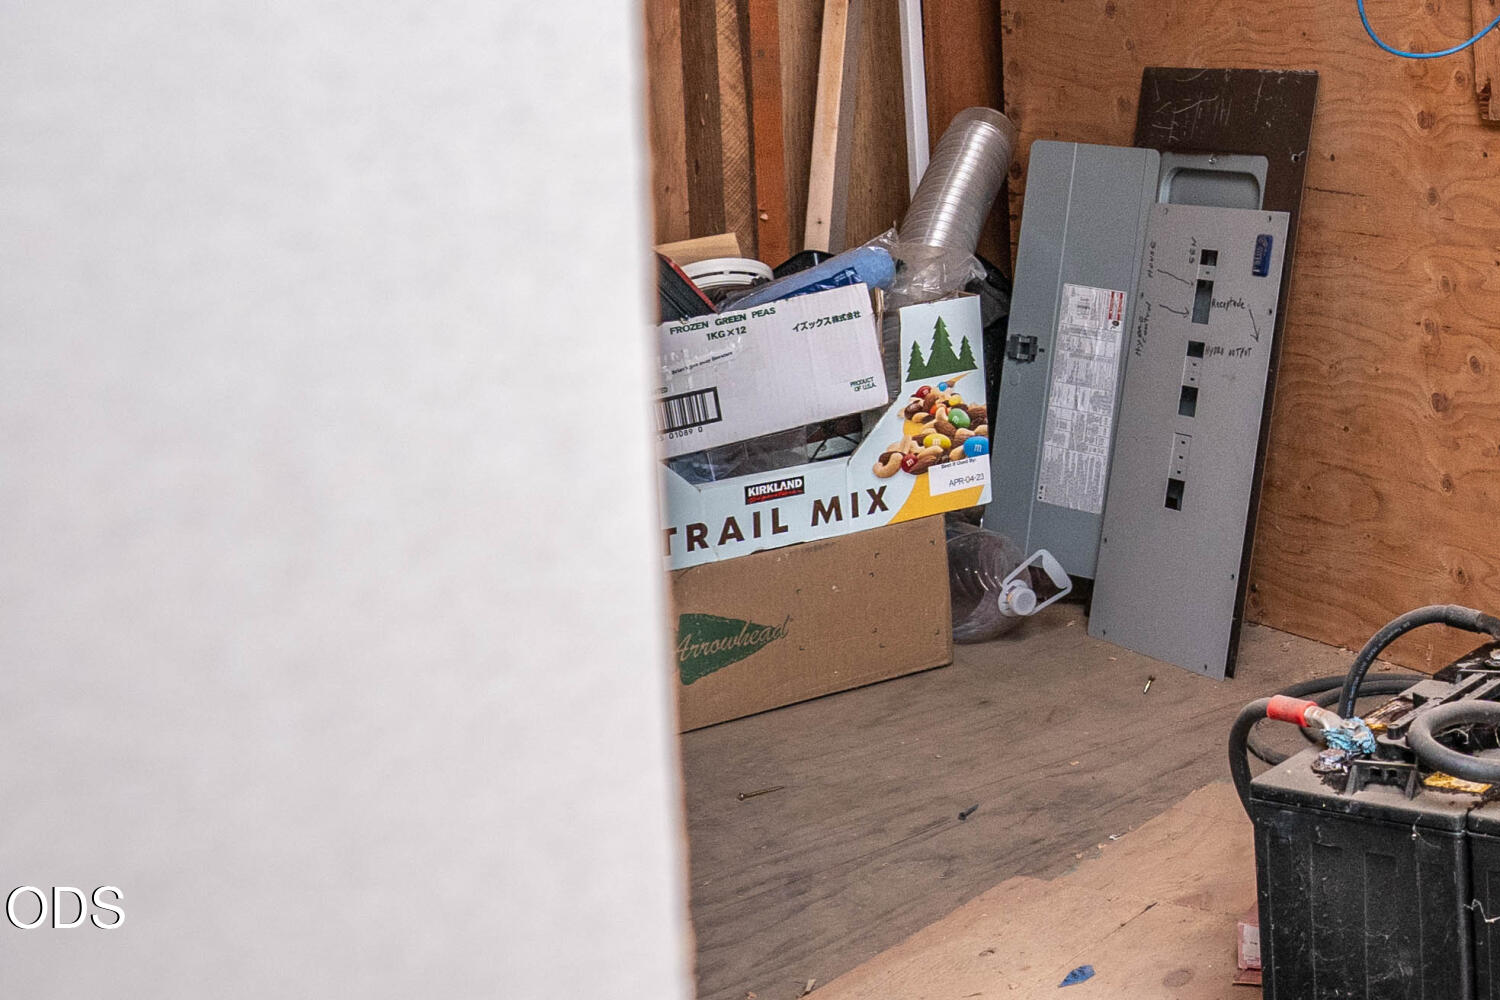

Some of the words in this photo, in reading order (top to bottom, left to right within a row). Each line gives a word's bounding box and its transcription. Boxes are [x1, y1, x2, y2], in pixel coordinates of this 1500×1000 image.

[669, 320, 710, 335] FROZEN
[714, 313, 747, 327] GREEN
[751, 306, 776, 319] PEAS
[850, 376, 874, 387] PRODUCT
[748, 478, 802, 497] KIRKLAND
[811, 485, 889, 527] MIX
[677, 614, 793, 661] Arrowhead
